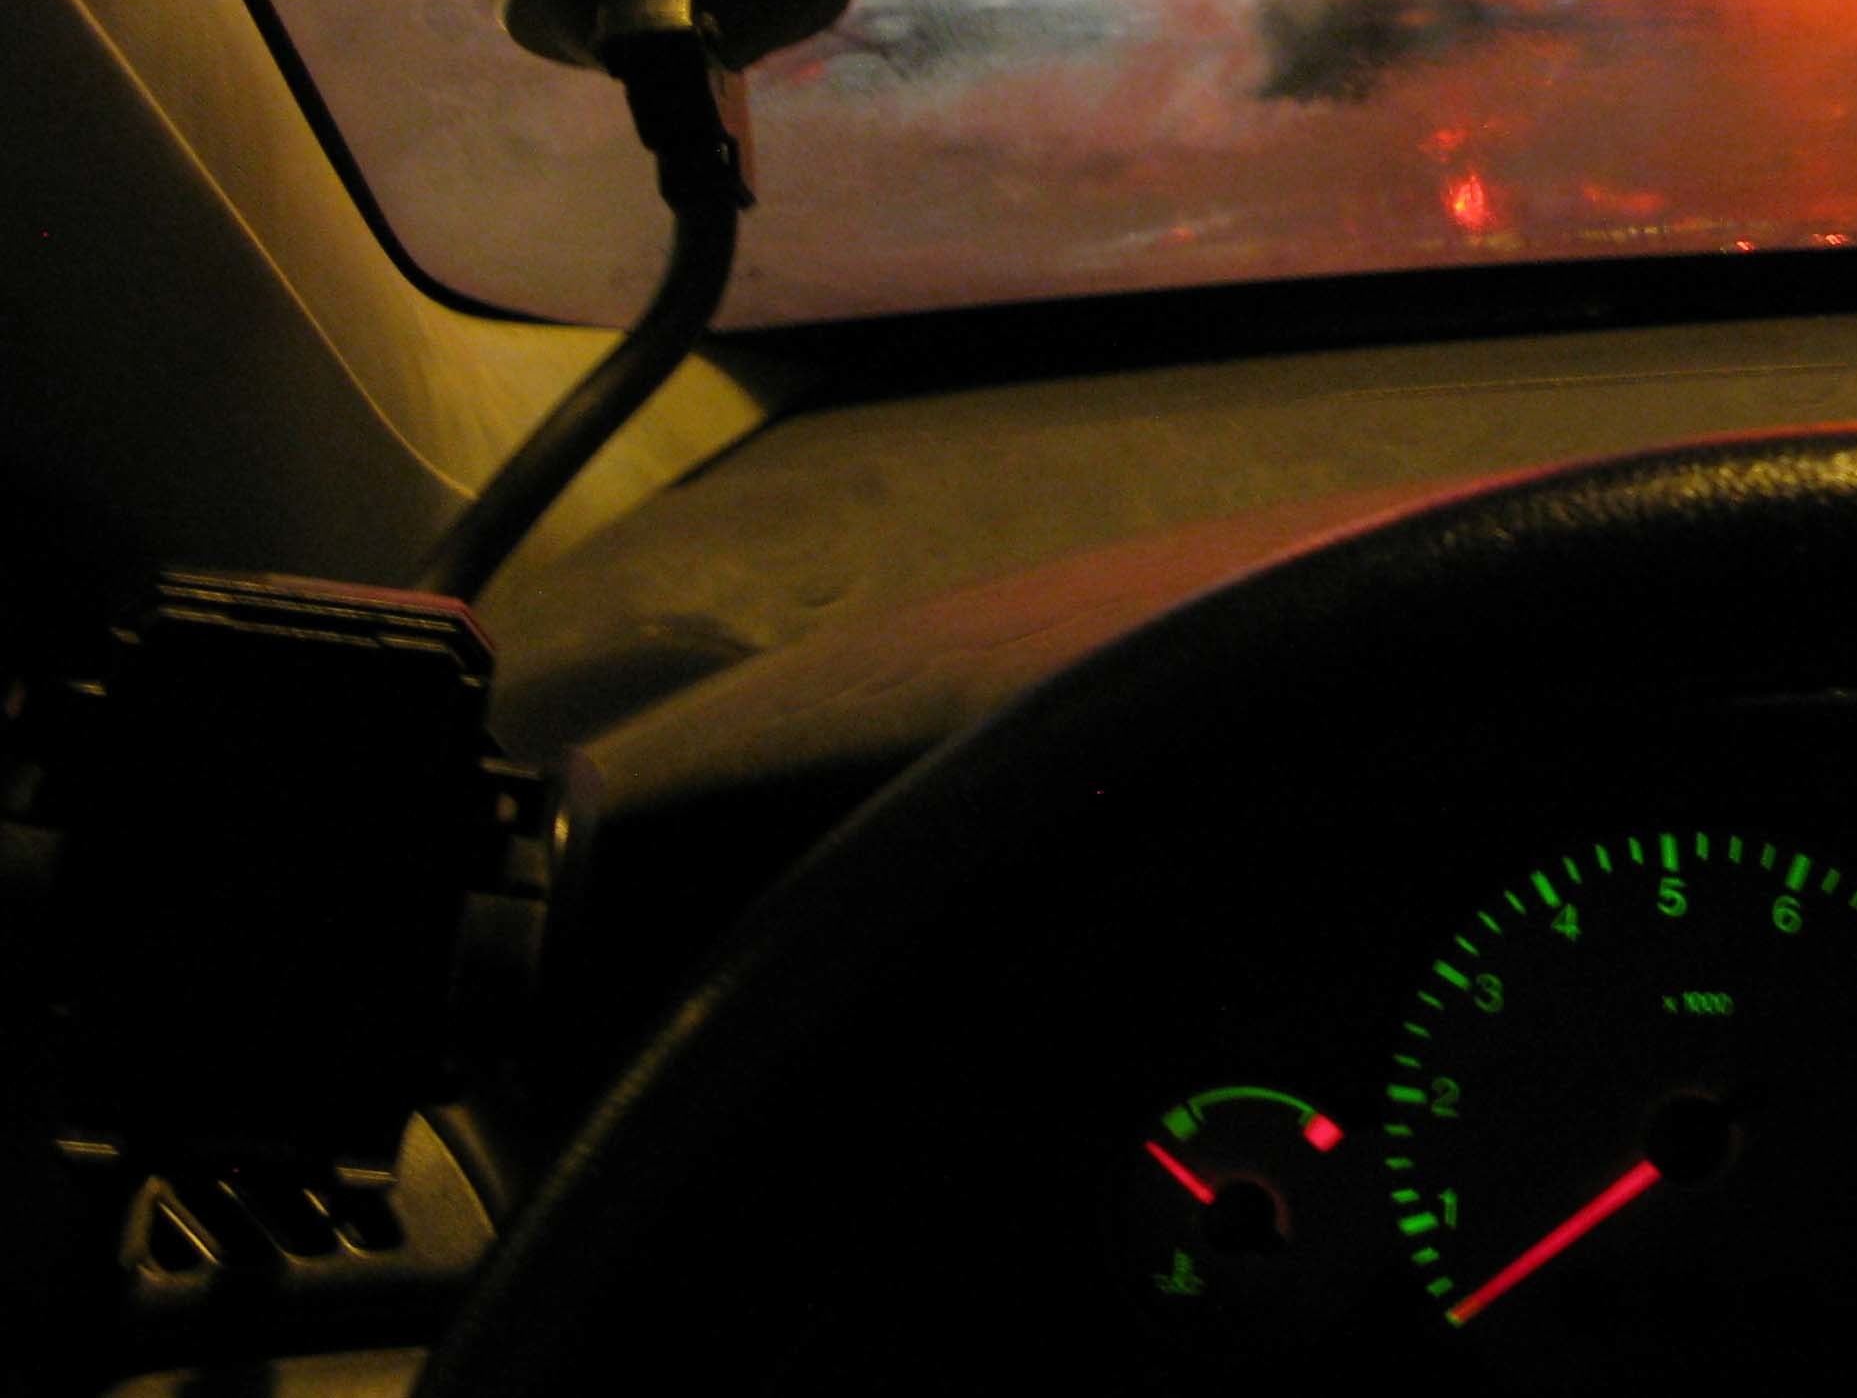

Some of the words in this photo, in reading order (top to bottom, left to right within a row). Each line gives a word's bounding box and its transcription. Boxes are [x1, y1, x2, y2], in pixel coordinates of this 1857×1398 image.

[1657, 876, 1688, 917] 5
[1772, 895, 1803, 934] 6
[1550, 904, 1582, 941] 4
[1473, 973, 1505, 1013] 3
[1431, 1077, 1461, 1118] 2
[1438, 1188, 1458, 1230] 1
